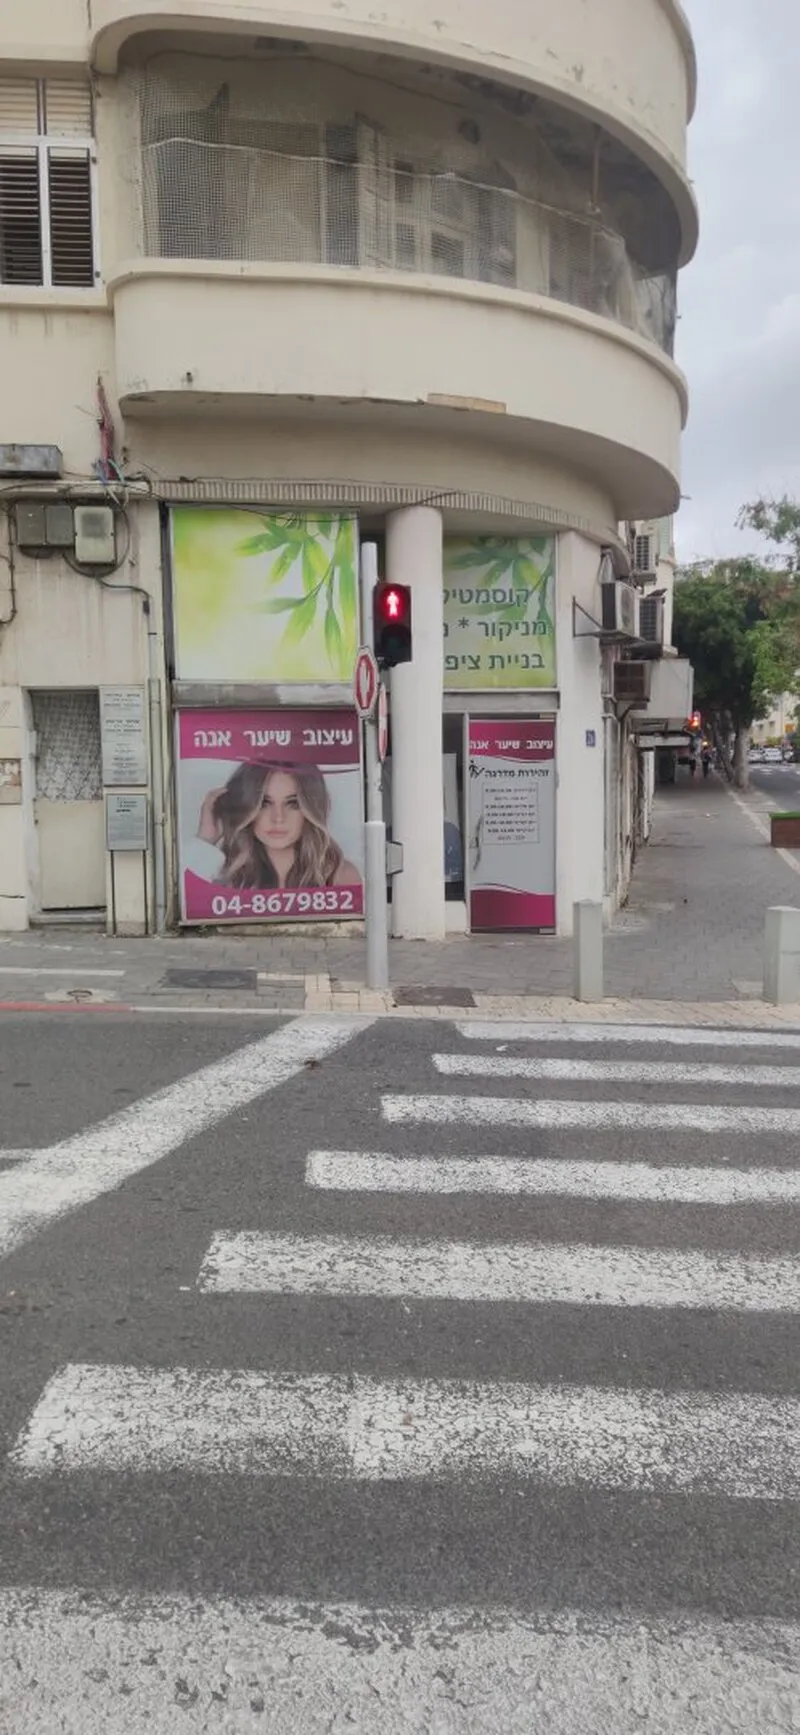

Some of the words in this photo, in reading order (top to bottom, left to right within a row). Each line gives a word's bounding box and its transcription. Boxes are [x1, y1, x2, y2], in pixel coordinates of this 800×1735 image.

[477, 620, 547, 642] מניקור
[488, 653, 545, 670] בניית
[193, 729, 232, 748] אנה
[243, 729, 291, 747] שיער
[302, 729, 353, 746] עיצוב
[470, 739, 489, 750] אנה
[495, 739, 520, 750] שיער
[526, 739, 554, 750] עיצוב
[211, 890, 353, 916] 04-8679832
